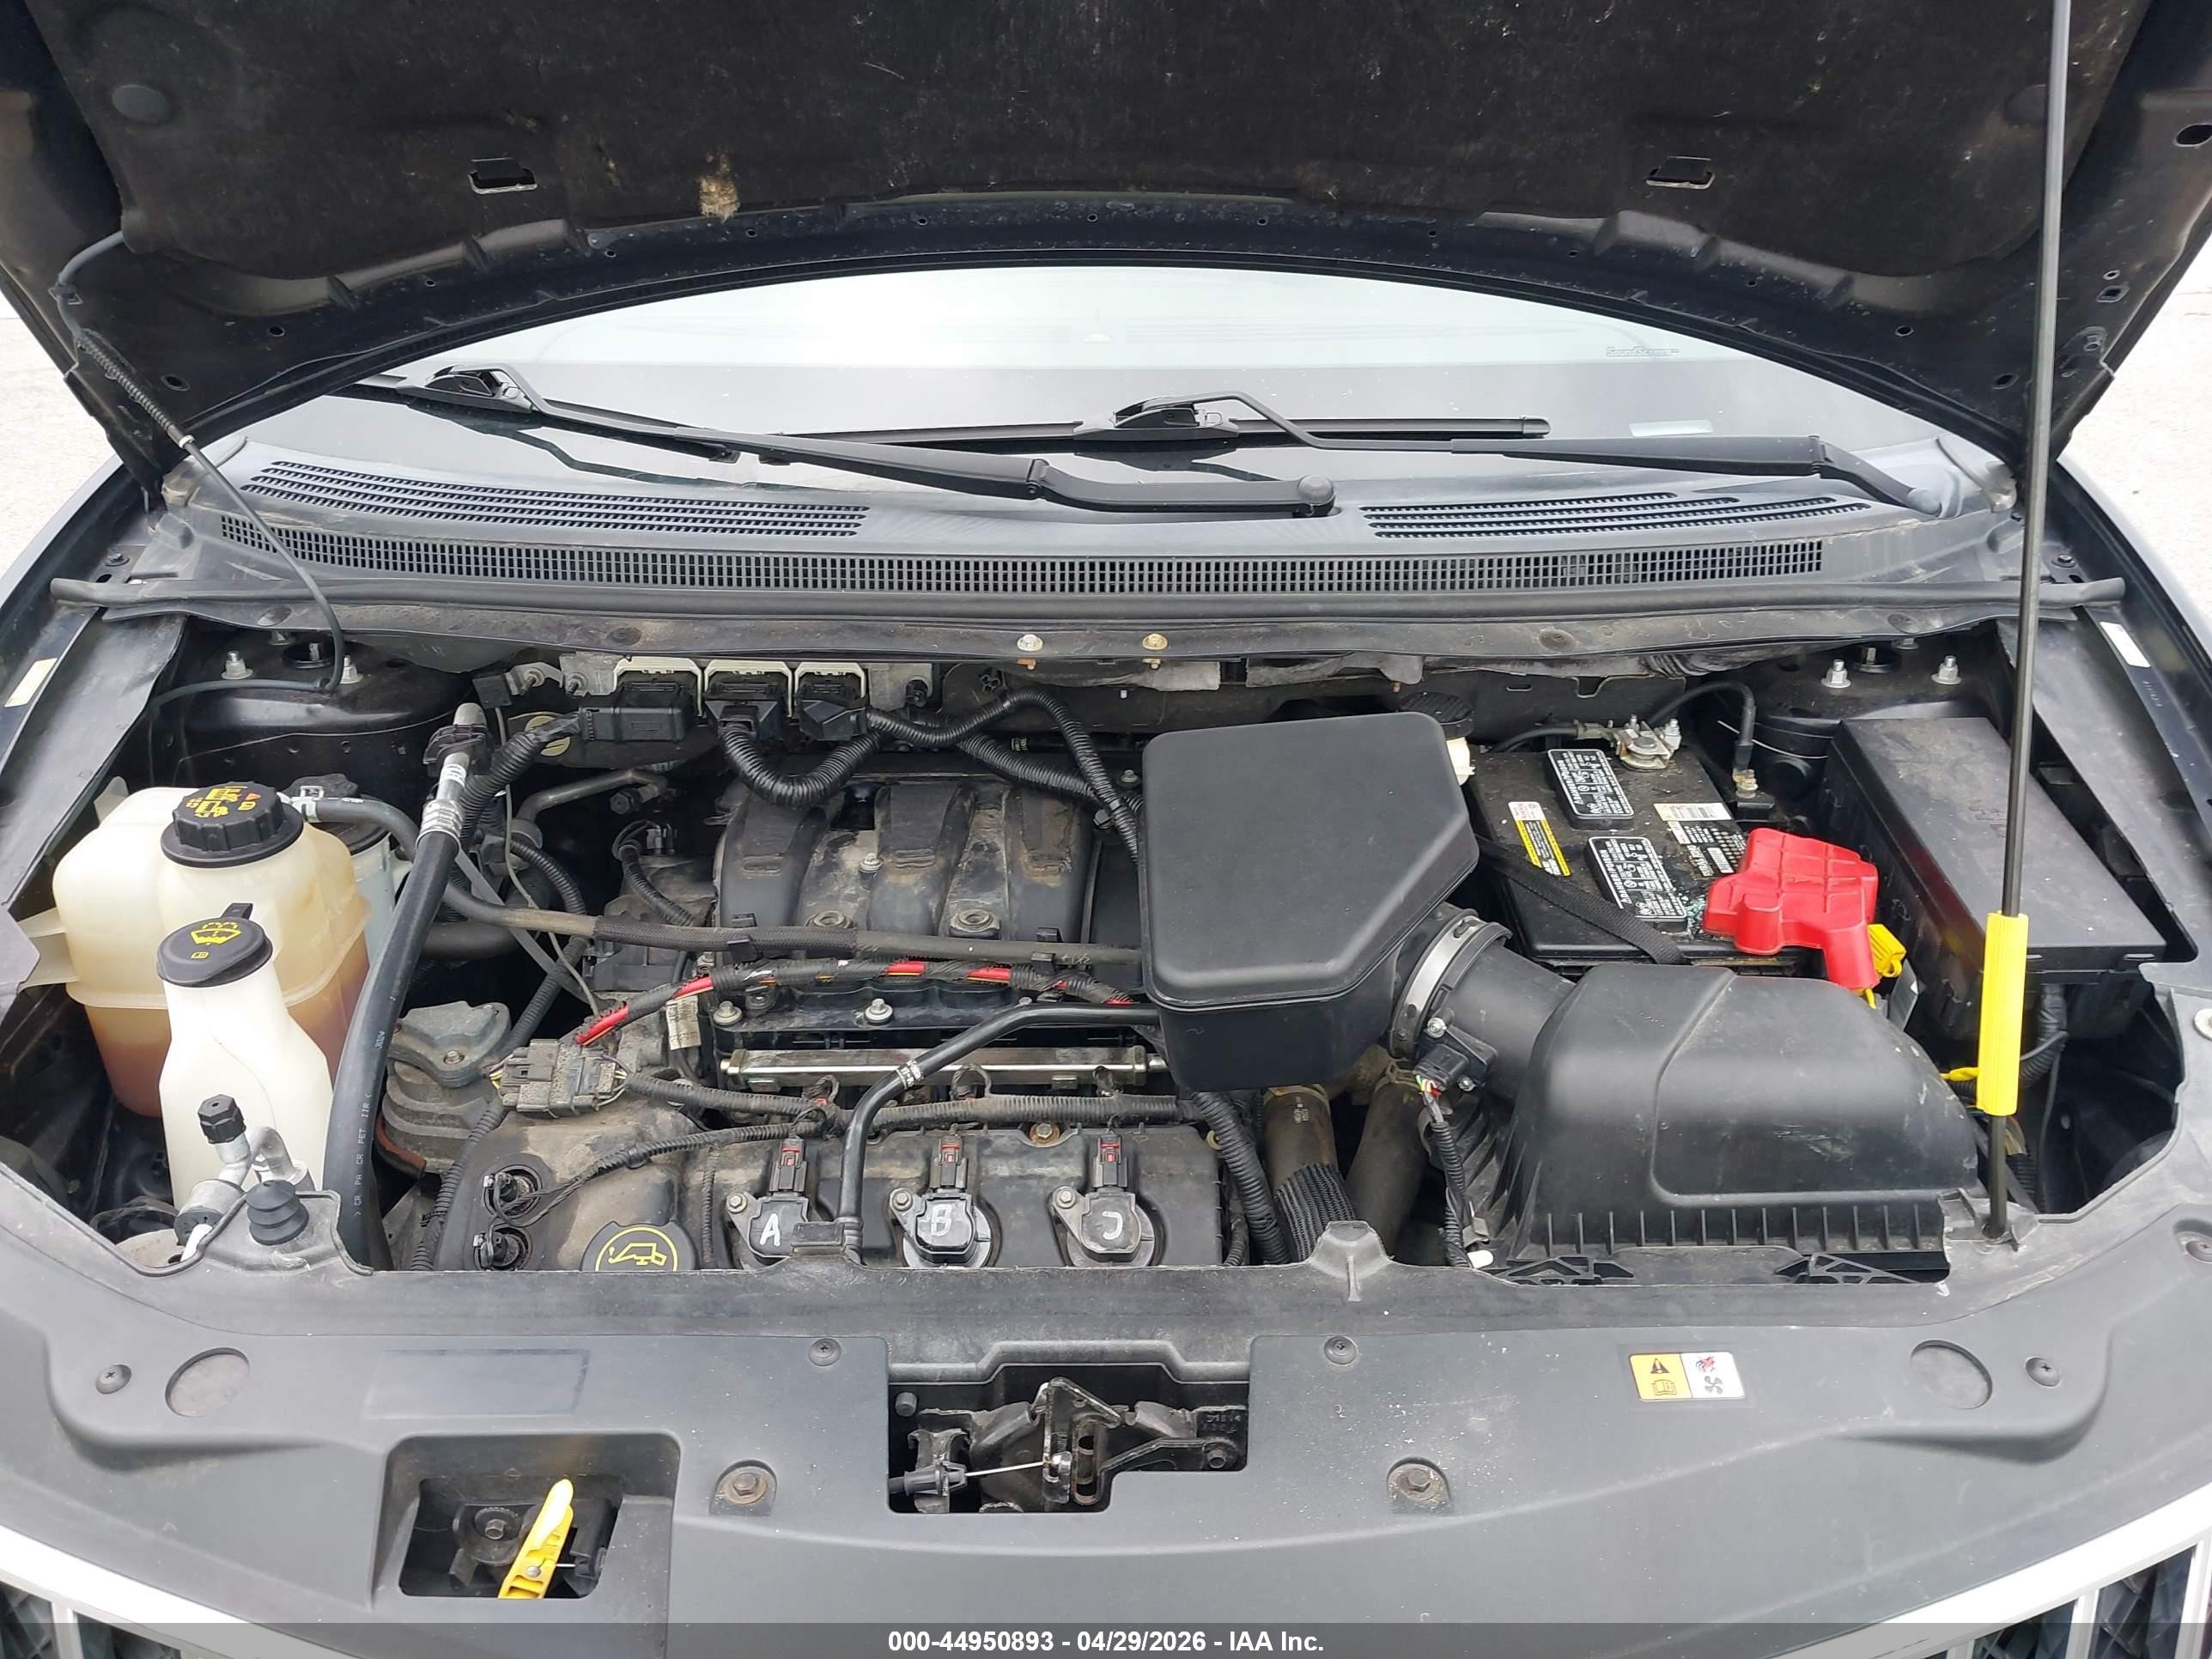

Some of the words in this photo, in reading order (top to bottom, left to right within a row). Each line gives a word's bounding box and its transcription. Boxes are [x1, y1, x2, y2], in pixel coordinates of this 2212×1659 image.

[357, 1128, 367, 1144] PET
[759, 1213, 781, 1247] A
[930, 1204, 952, 1237] B
